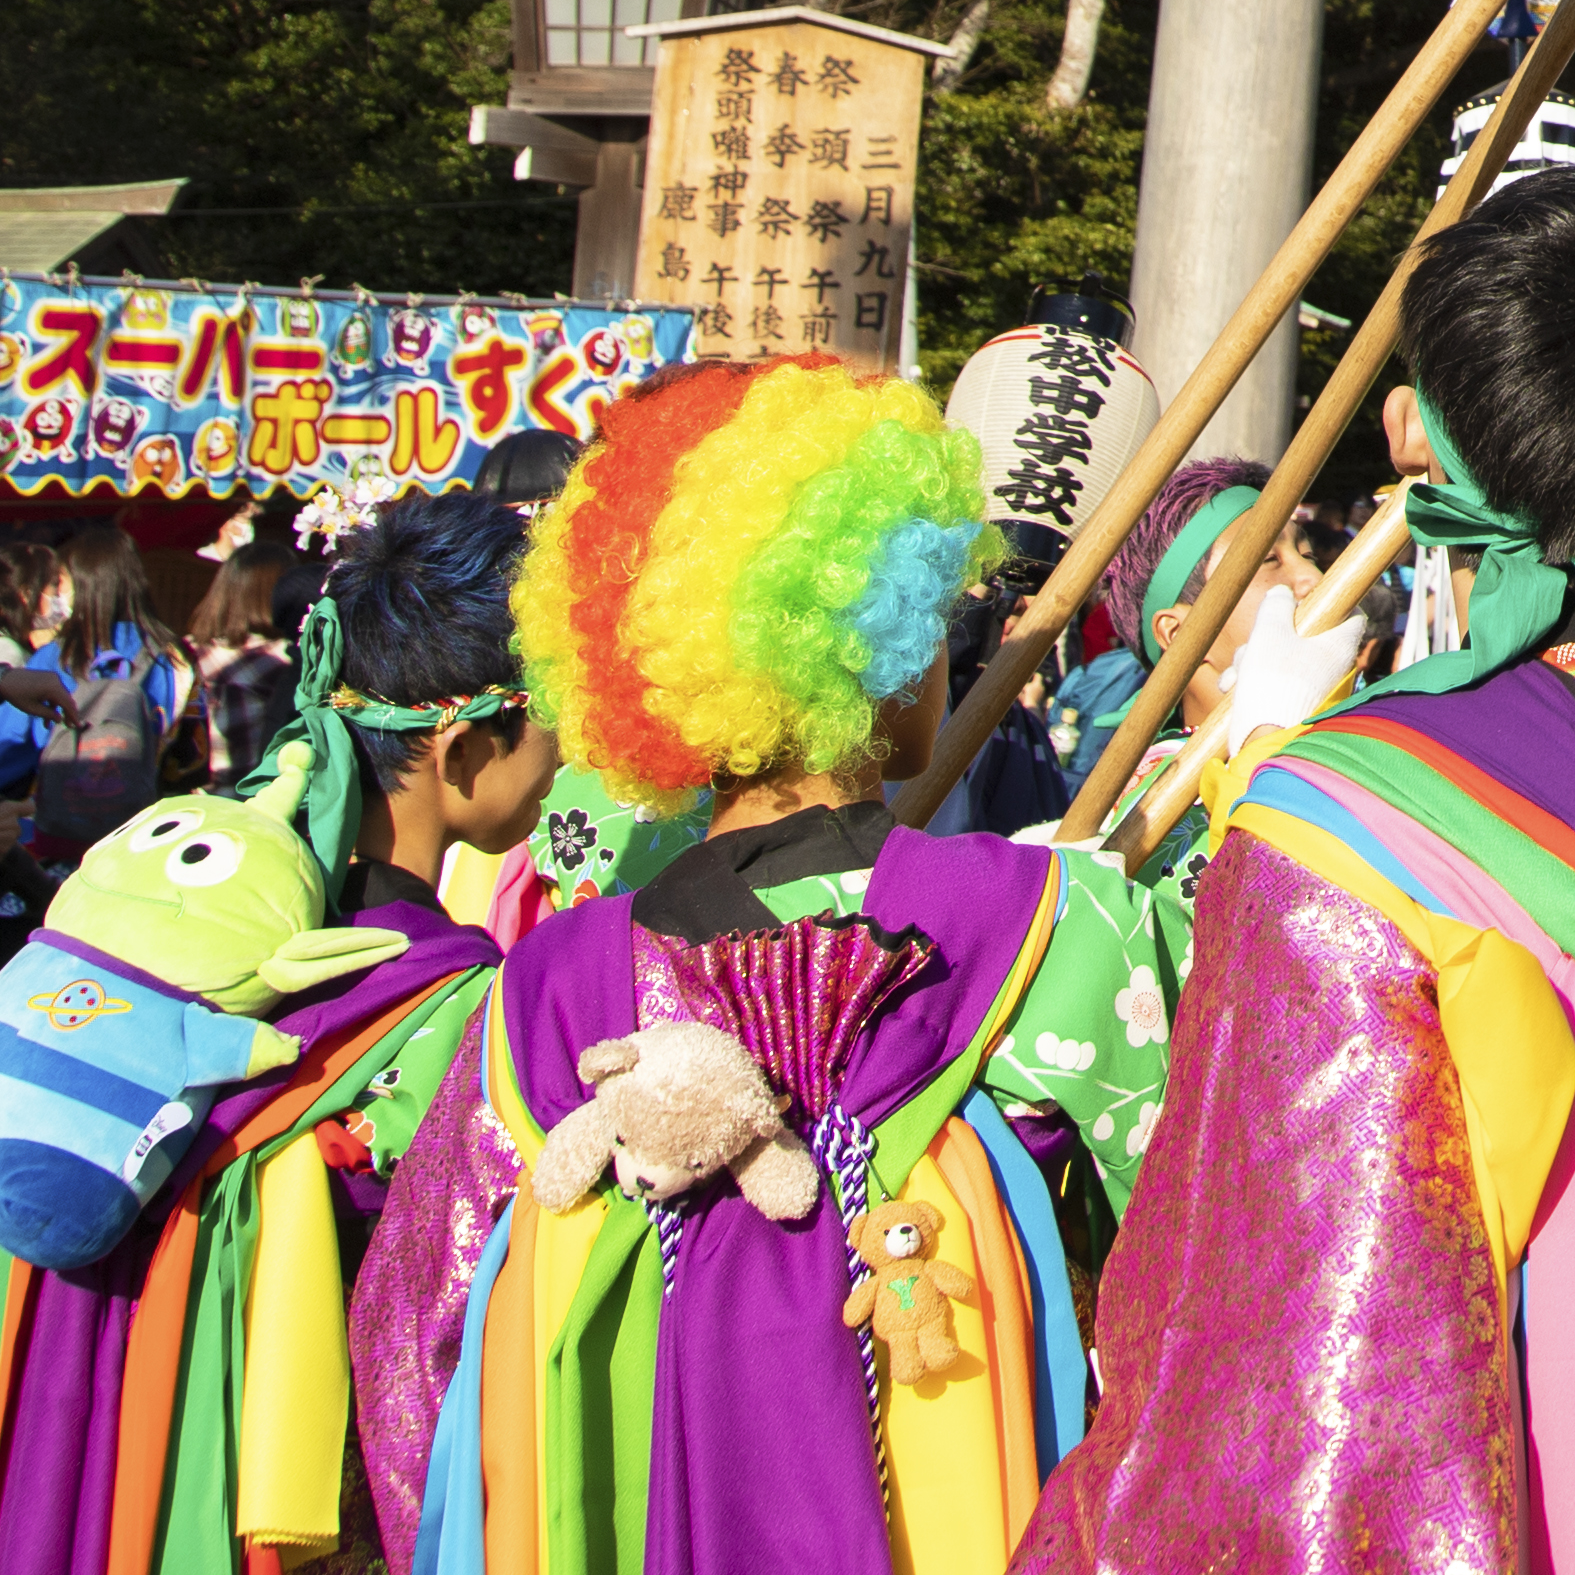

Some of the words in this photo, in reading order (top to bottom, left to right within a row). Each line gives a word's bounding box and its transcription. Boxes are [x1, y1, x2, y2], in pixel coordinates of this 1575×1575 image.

[656, 180, 700, 282] 鹿島
[854, 133, 902, 333] 三月九日
[22, 305, 324, 403] スーパー
[450, 335, 638, 443] すく
[248, 378, 460, 475] ボール
